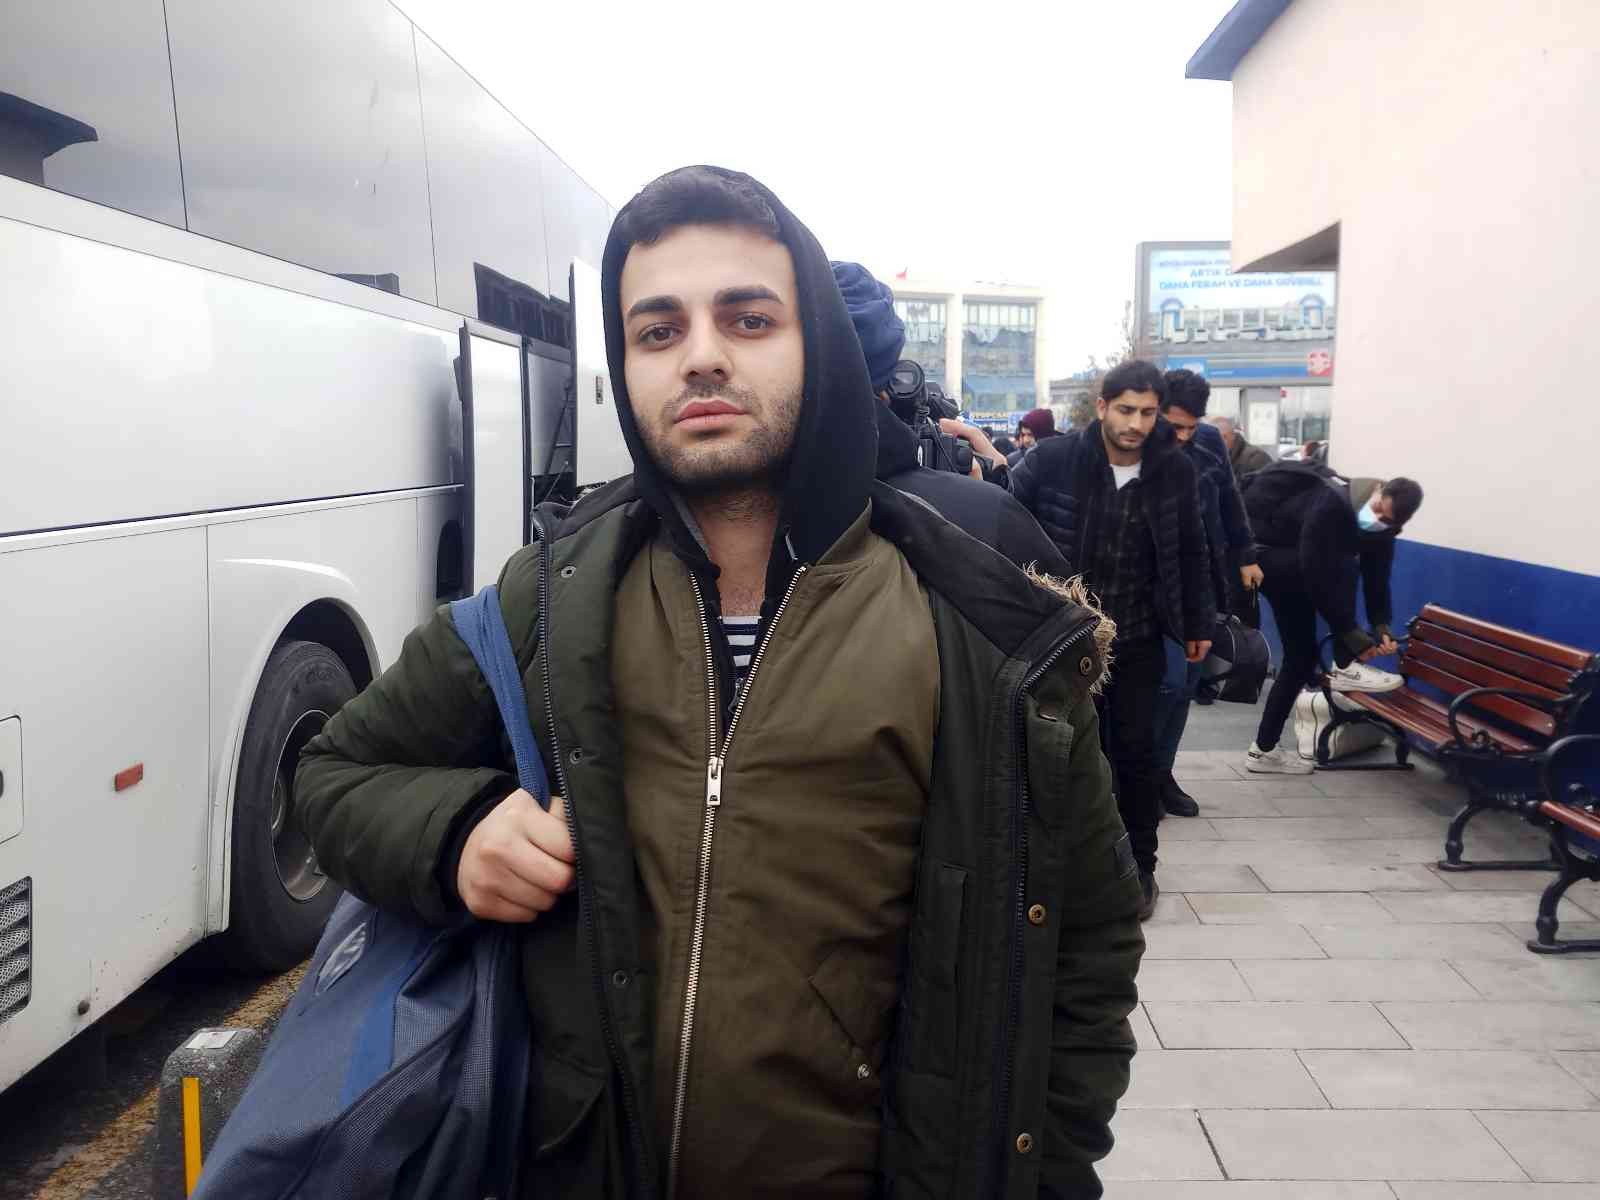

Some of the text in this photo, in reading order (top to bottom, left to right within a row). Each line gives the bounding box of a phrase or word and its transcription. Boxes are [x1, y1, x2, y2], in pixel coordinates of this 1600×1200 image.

[1159, 280, 1189, 290] DAHA
[1191, 280, 1226, 289] FERAH
[1243, 278, 1273, 287] DAHA
